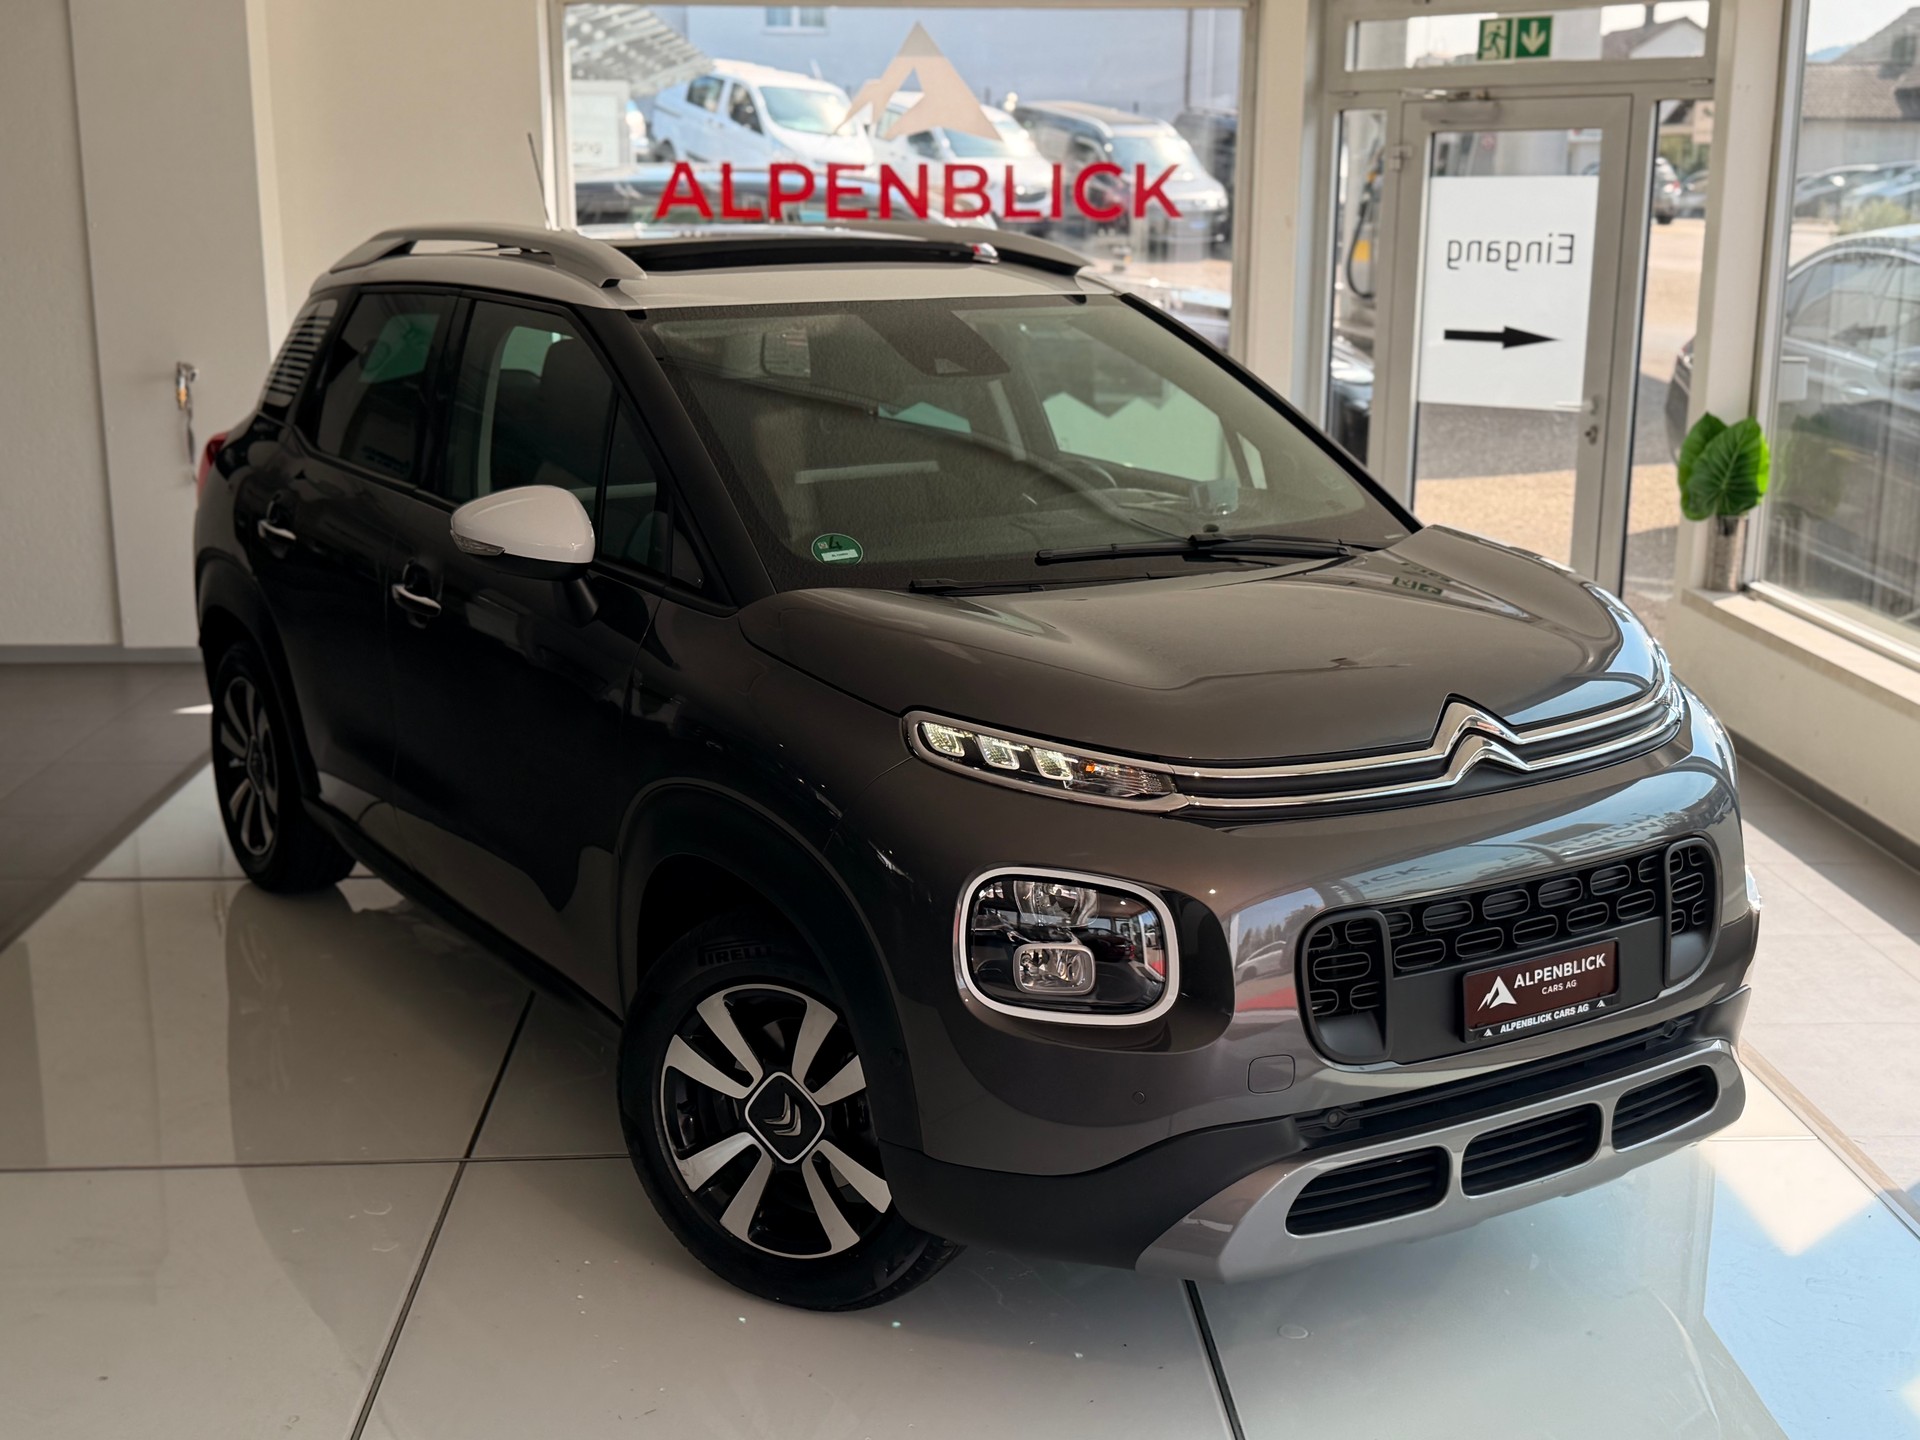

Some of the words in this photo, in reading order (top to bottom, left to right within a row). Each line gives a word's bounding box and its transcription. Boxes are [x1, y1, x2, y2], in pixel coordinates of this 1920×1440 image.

[654, 162, 1181, 221] ALPENBLICK
[697, 940, 772, 966] PIRELLI
[1514, 953, 1606, 988] ALPENBLICK
[1541, 983, 1563, 994] CARS
[1565, 979, 1577, 988] AG
[1500, 1012, 1552, 1033] ALPENBLICK
[1553, 1007, 1576, 1019] CARS
[1577, 1004, 1589, 1013] AG
